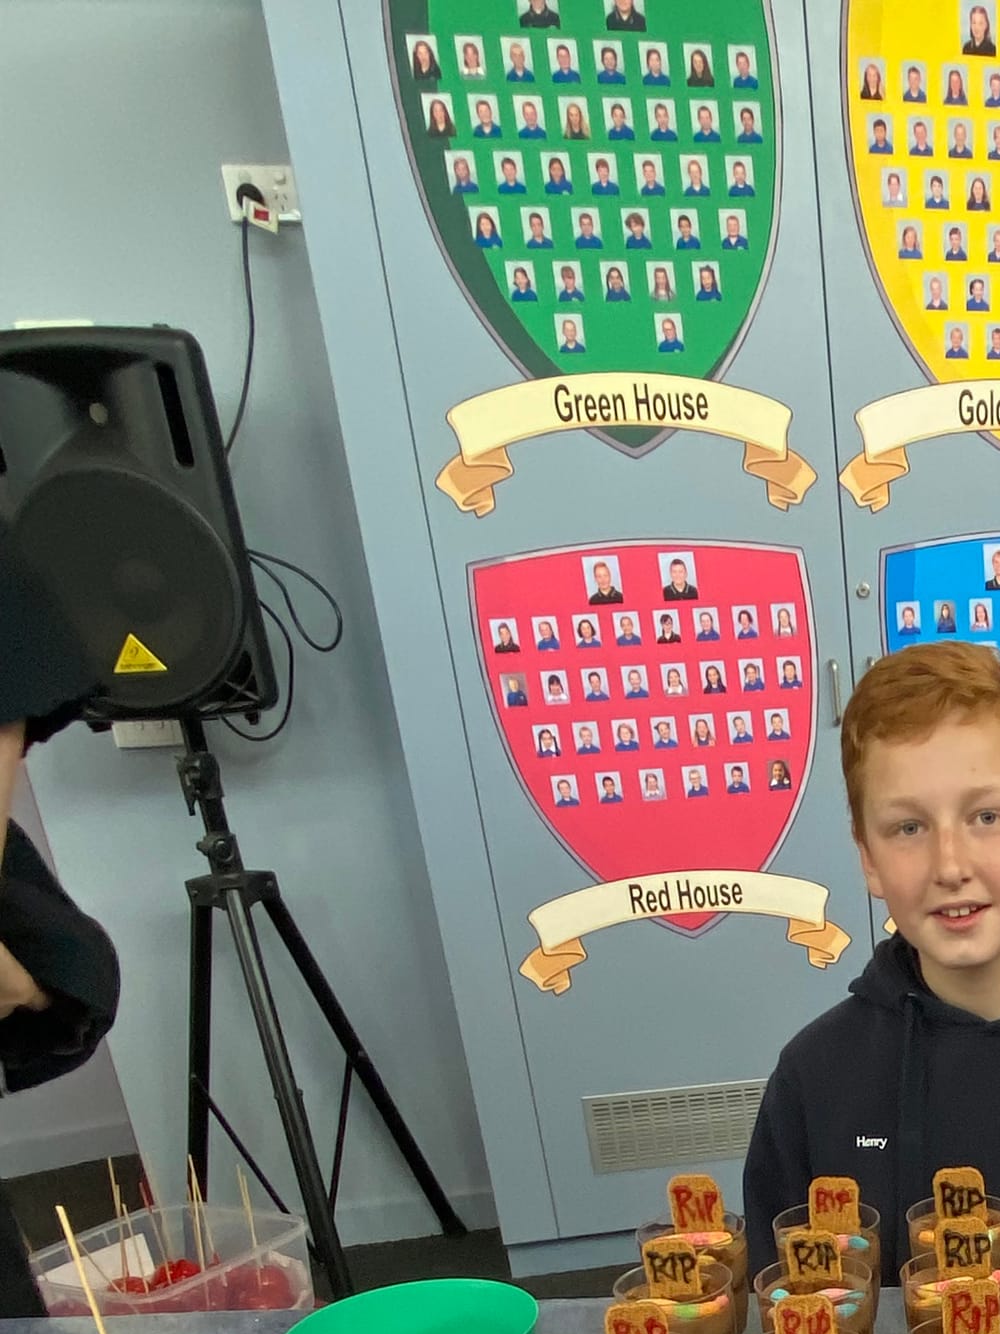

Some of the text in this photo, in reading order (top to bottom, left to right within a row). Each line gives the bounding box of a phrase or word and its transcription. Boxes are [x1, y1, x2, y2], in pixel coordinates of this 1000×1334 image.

[553, 383, 709, 423] Green House
[628, 879, 743, 914] Red House
[856, 1135, 888, 1150] Henry
